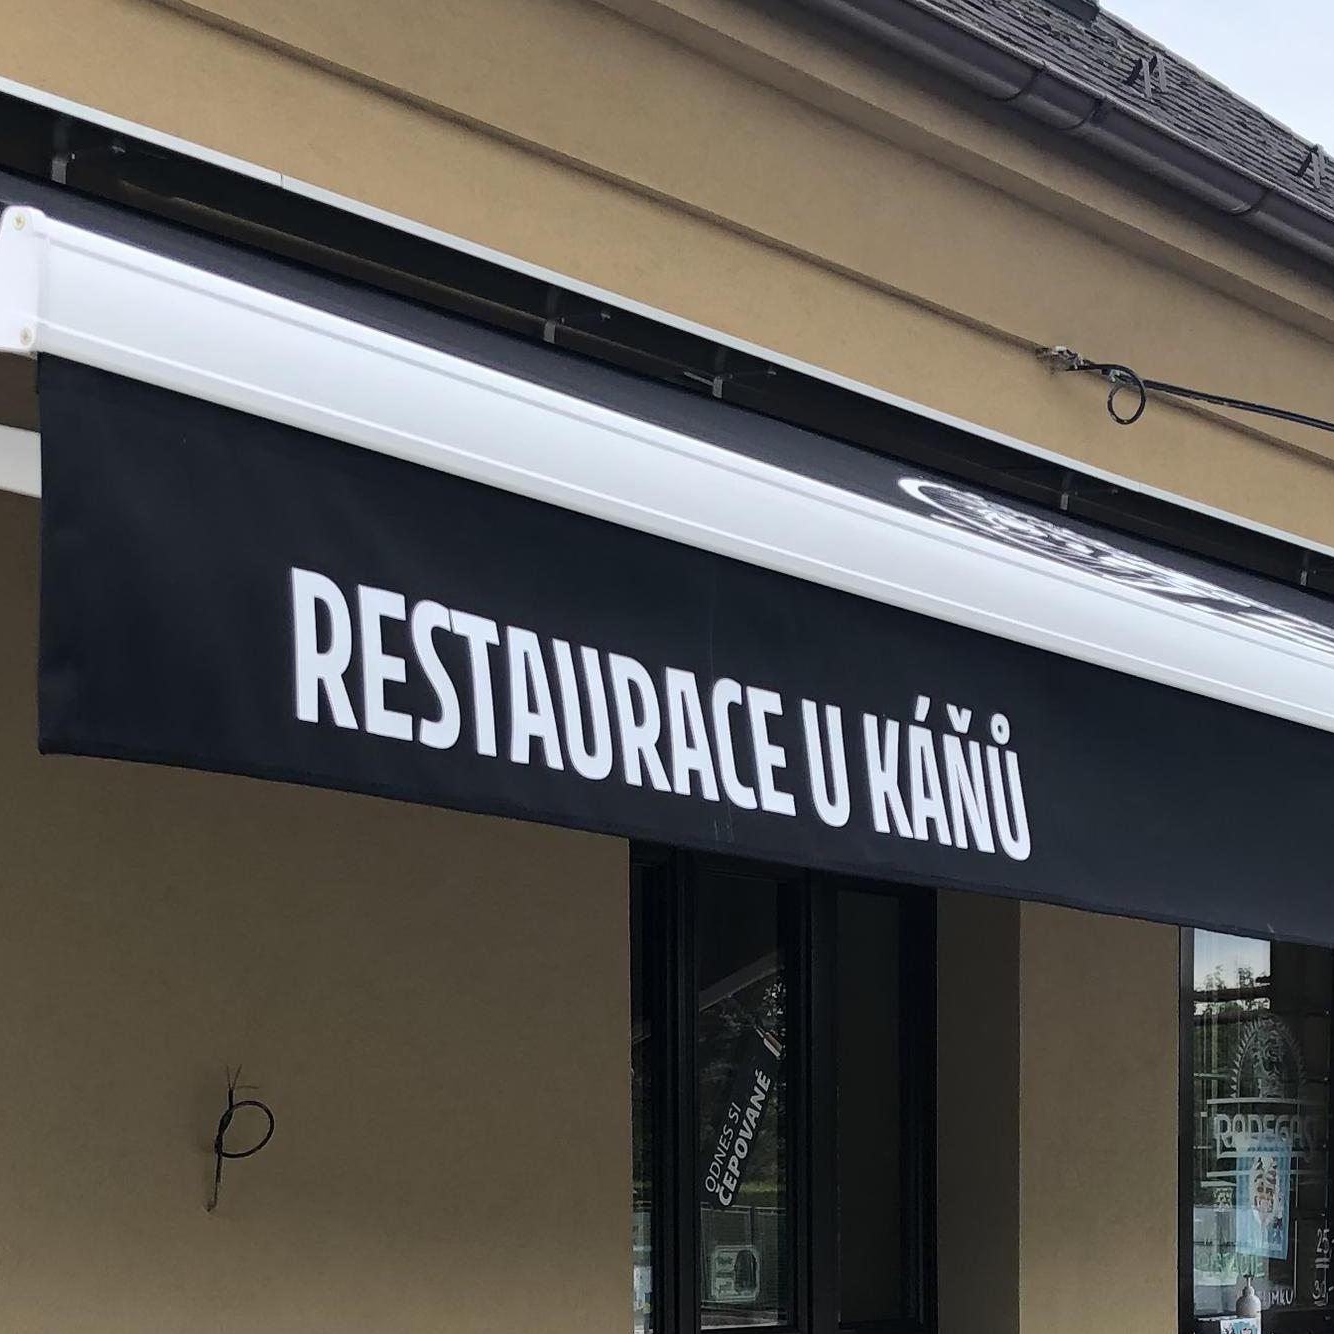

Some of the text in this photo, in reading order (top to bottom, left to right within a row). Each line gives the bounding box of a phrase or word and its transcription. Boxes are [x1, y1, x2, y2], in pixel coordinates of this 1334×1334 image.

[291, 566, 1032, 862] RESTAURACE U KÁŇŮ
[705, 1102, 742, 1193] ODNES SI
[715, 1068, 771, 1207] ČEPOVANÉ
